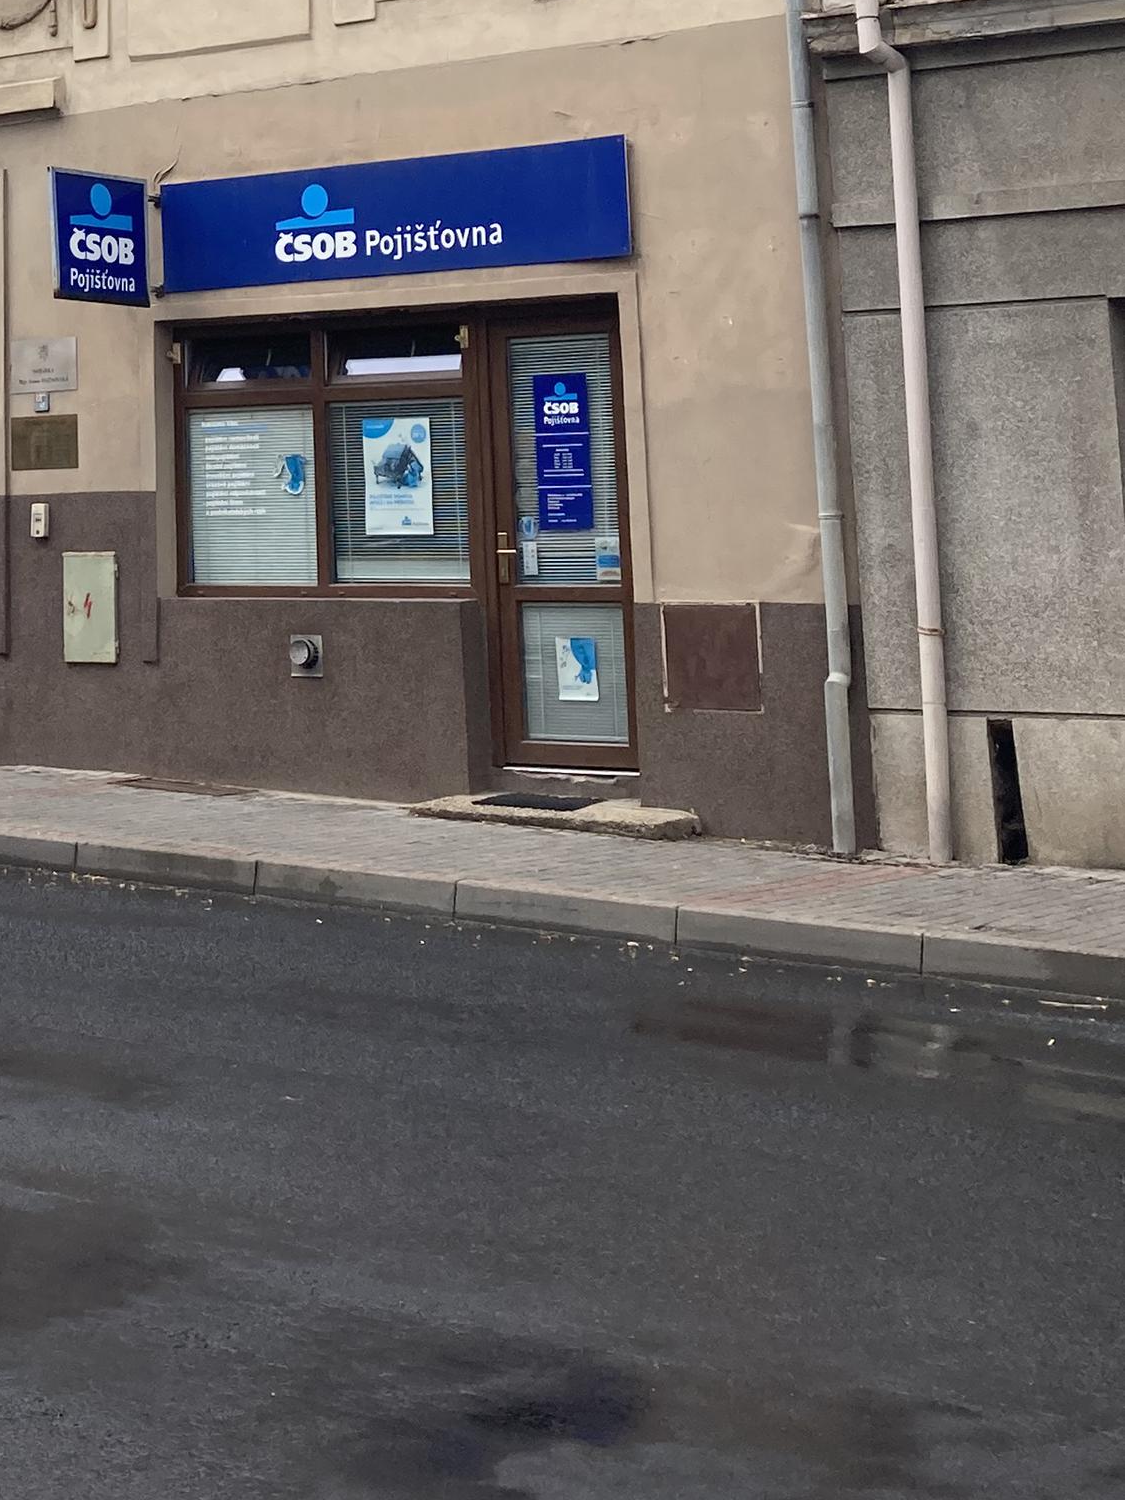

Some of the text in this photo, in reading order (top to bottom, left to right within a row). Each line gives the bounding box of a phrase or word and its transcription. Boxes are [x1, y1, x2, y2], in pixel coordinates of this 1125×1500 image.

[69, 227, 135, 265] ČSOB
[275, 220, 503, 263] ČSOB Pojišťovna
[70, 267, 135, 292] Pojišťovna
[543, 401, 579, 415] ČSOB
